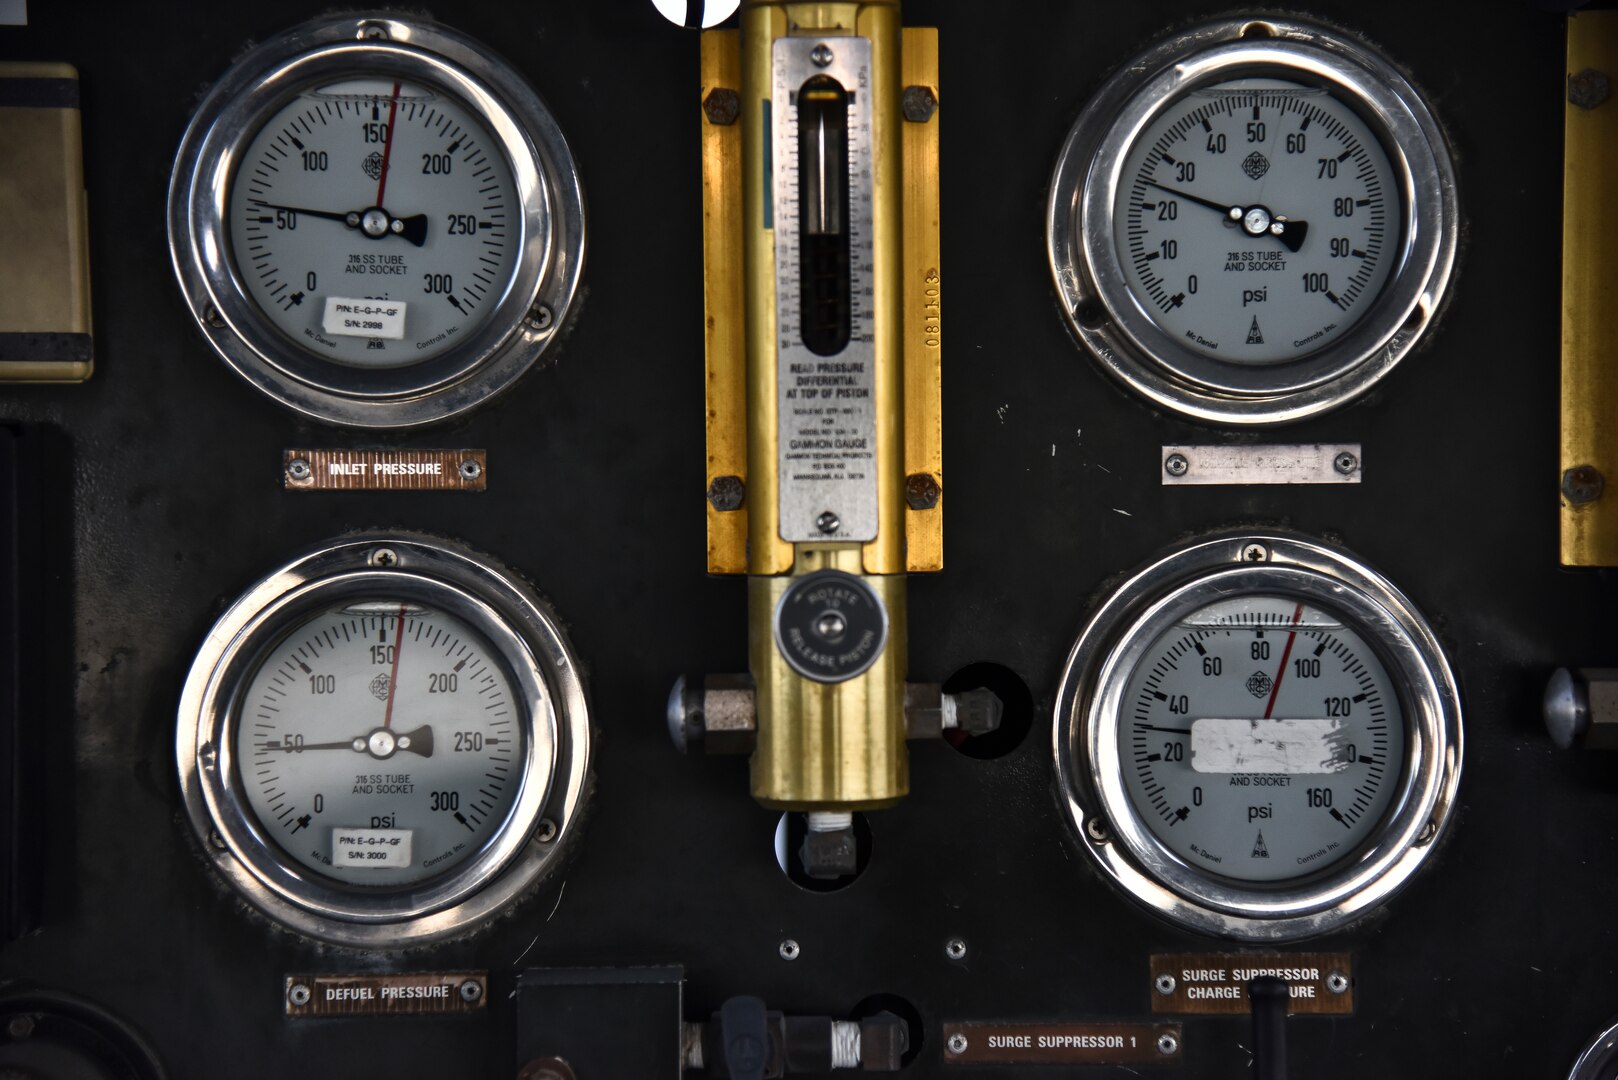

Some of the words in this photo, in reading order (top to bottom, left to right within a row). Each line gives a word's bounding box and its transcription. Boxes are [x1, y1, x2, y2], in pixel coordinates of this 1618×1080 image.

[362, 123, 389, 144] 150
[1247, 122, 1266, 143] 50
[1206, 133, 1226, 154] 40
[1286, 133, 1305, 154] 60
[302, 151, 328, 172] 100
[422, 154, 452, 175] 200
[1175, 161, 1195, 182] 30
[1318, 159, 1337, 179] 70
[1158, 200, 1177, 221] 20
[1334, 197, 1353, 217] 80
[276, 210, 296, 231] 50
[448, 215, 476, 236] 250
[1161, 239, 1177, 260] 10
[1227, 252, 1240, 261] 316
[1241, 252, 1254, 261] SS
[1256, 251, 1283, 260] TUBE
[1330, 238, 1349, 258] 90
[345, 264, 366, 275] AND
[368, 265, 408, 275] SOCKET
[348, 254, 360, 265] 316
[362, 254, 375, 265] SS
[378, 255, 404, 265] TUBE
[1224, 262, 1245, 272] AND
[1248, 261, 1287, 271] SOCKET
[306, 271, 316, 291] 0
[424, 274, 453, 295] 300
[1188, 275, 1198, 295] 0
[1303, 273, 1329, 293] 100
[1242, 286, 1267, 307] psi
[315, 334, 337, 348] Daniel
[416, 333, 446, 350] Controls
[447, 326, 459, 335] Inc.
[1197, 335, 1219, 350] Daniel
[1293, 330, 1324, 348] Controls
[1324, 323, 1337, 332] Inc.
[817, 362, 864, 373] PRESSURE
[796, 375, 860, 387] DIFFERENTIAL
[786, 388, 799, 399] AT
[801, 388, 818, 399] TOP
[821, 388, 833, 399] OF
[836, 388, 869, 398] PISTON
[834, 438, 867, 449] GAUGE
[330, 463, 368, 475] INLET
[374, 463, 442, 475] PRESSURE
[808, 587, 858, 604] ROTATE
[370, 645, 395, 665] 150
[789, 627, 835, 667] RELEASE
[838, 629, 875, 666] PISTON
[1250, 641, 1270, 661] 80
[1203, 657, 1222, 677] 60
[1294, 658, 1321, 679] 100
[309, 674, 335, 694] 100
[429, 673, 458, 694] 200
[1169, 695, 1189, 715] 40
[1324, 697, 1351, 717] 120
[284, 734, 304, 754] 50
[454, 732, 482, 752] 250
[1164, 743, 1183, 762] 20
[352, 785, 373, 794] AND
[376, 785, 415, 794] SOCKET
[370, 775, 382, 784] SS
[385, 775, 411, 784] TUBE
[1229, 777, 1250, 786] AND
[1253, 777, 1291, 786] SOCKET
[314, 793, 323, 813] 0
[430, 791, 459, 811] 300
[1193, 786, 1203, 807] 0
[1307, 788, 1332, 808] 160
[371, 812, 395, 829] psi
[1248, 802, 1272, 823] psi
[339, 837, 355, 845] P/N:
[348, 851, 365, 859] S/N:
[367, 852, 387, 860] 3000
[423, 851, 453, 868] Controls
[1200, 849, 1222, 864] Daniel
[1296, 848, 1327, 865] Controls
[1327, 841, 1340, 851] Inc.
[1182, 969, 1226, 982] SURGE
[326, 987, 375, 1001] DEFUEL
[381, 985, 449, 999] PRESSURE
[1187, 987, 1241, 999] CHARGE
[988, 1036, 1031, 1048] SURGE
[1038, 1036, 1123, 1048] SUPPRESSOR
[1130, 1036, 1137, 1048] 1
